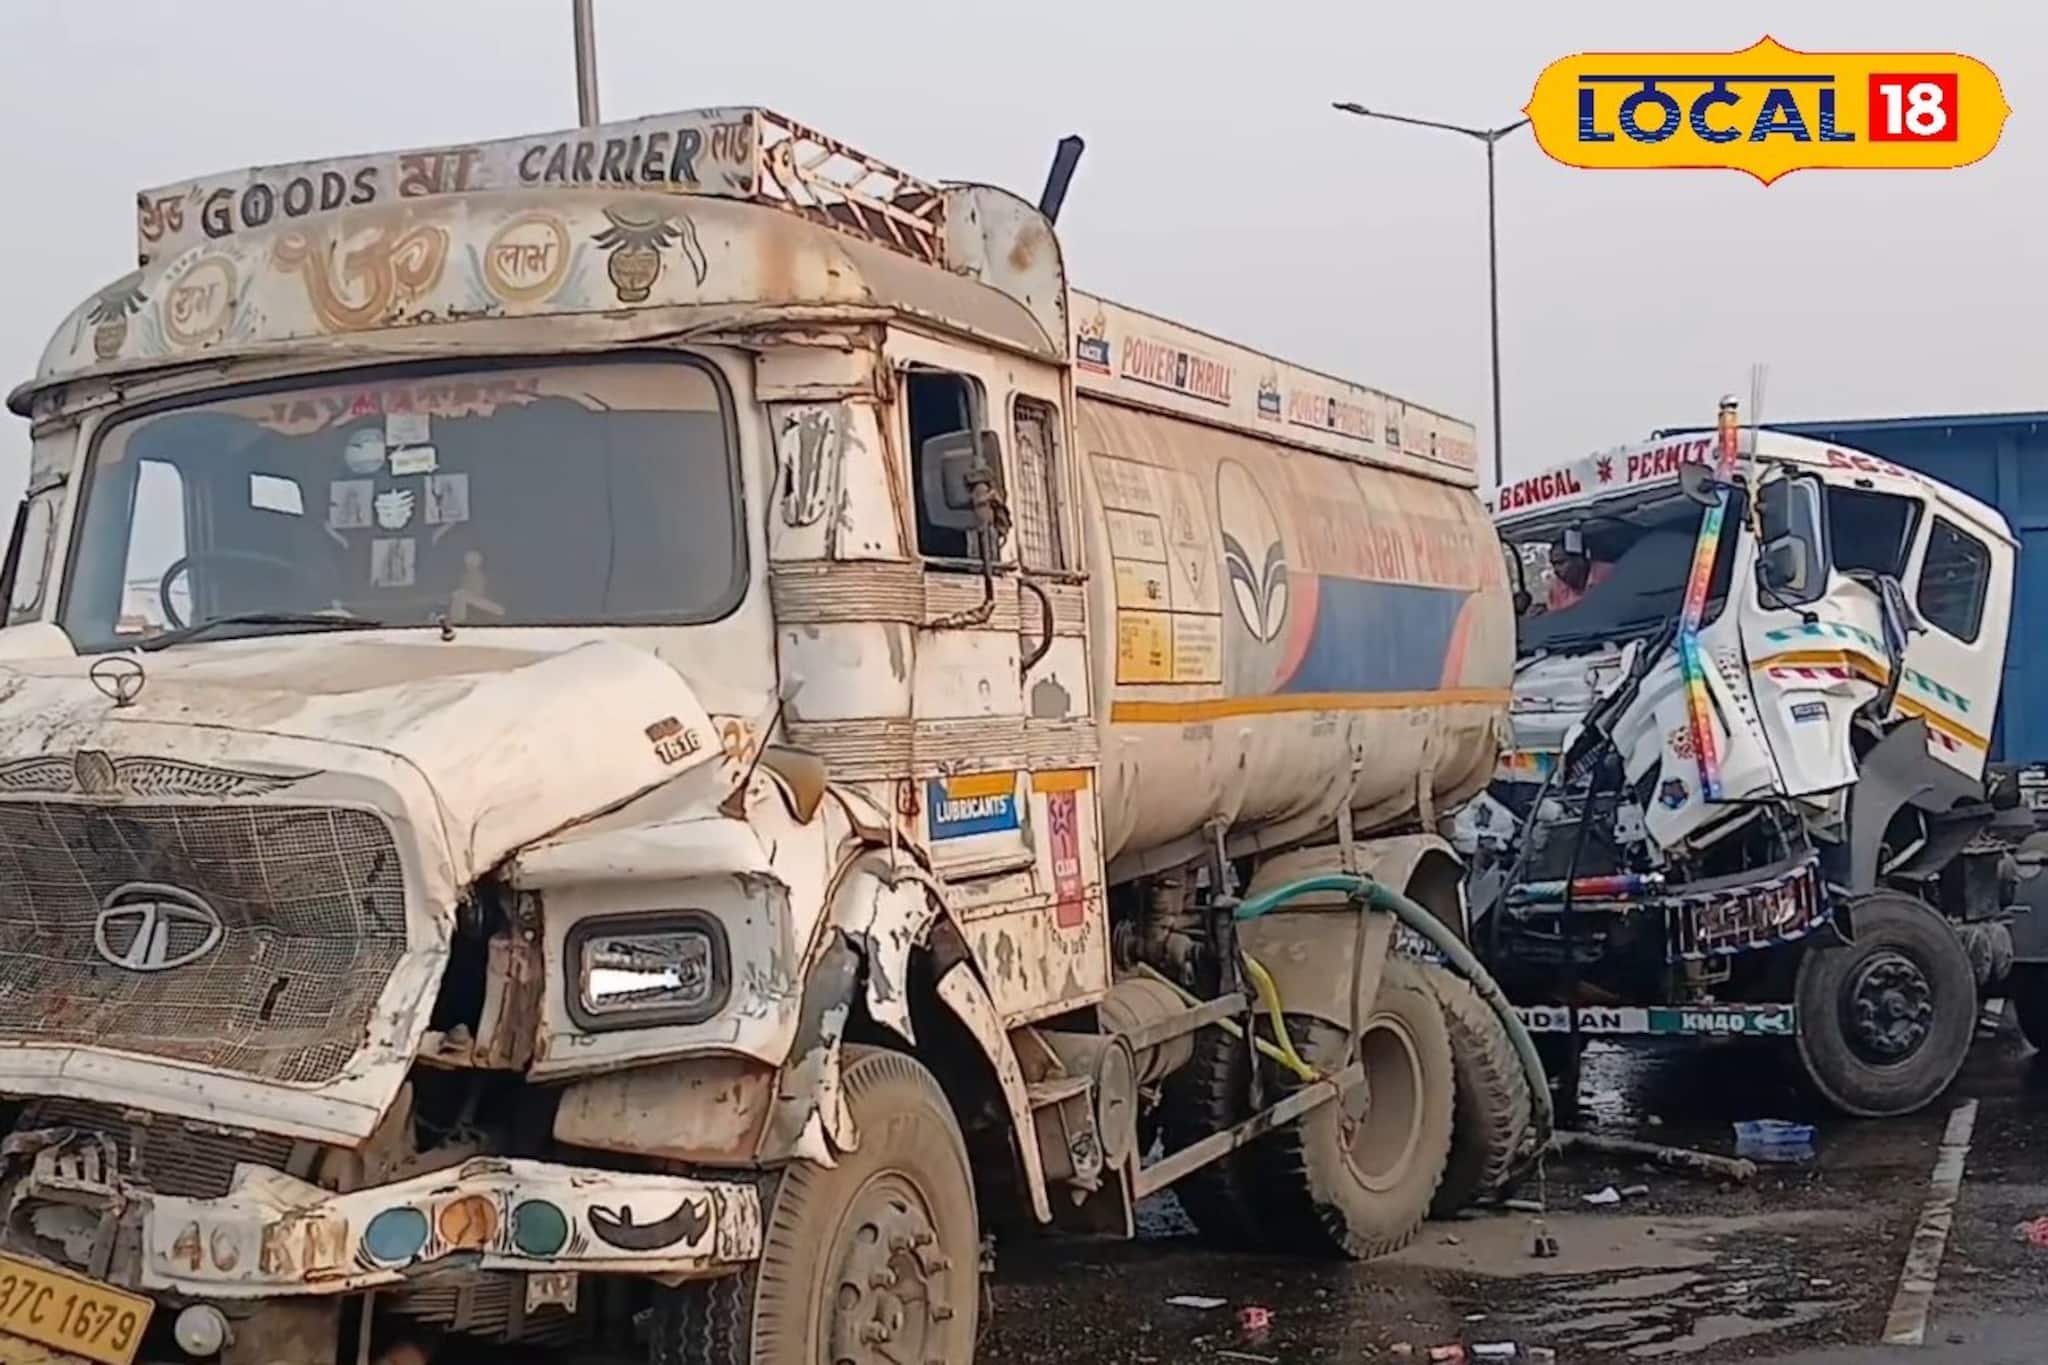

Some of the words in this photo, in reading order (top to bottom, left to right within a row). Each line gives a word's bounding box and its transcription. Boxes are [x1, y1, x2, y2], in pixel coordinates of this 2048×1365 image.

[518, 128, 701, 184] CARRIER
[202, 167, 378, 239] GOODS
[1122, 336, 1175, 385] POWER
[1189, 356, 1232, 400] THRILL
[1500, 468, 1582, 511] BENGAL
[1627, 439, 1712, 483] PERMIT
[935, 795, 1008, 823] LUBRICANTS
[58, 1294, 137, 1351] 1679
